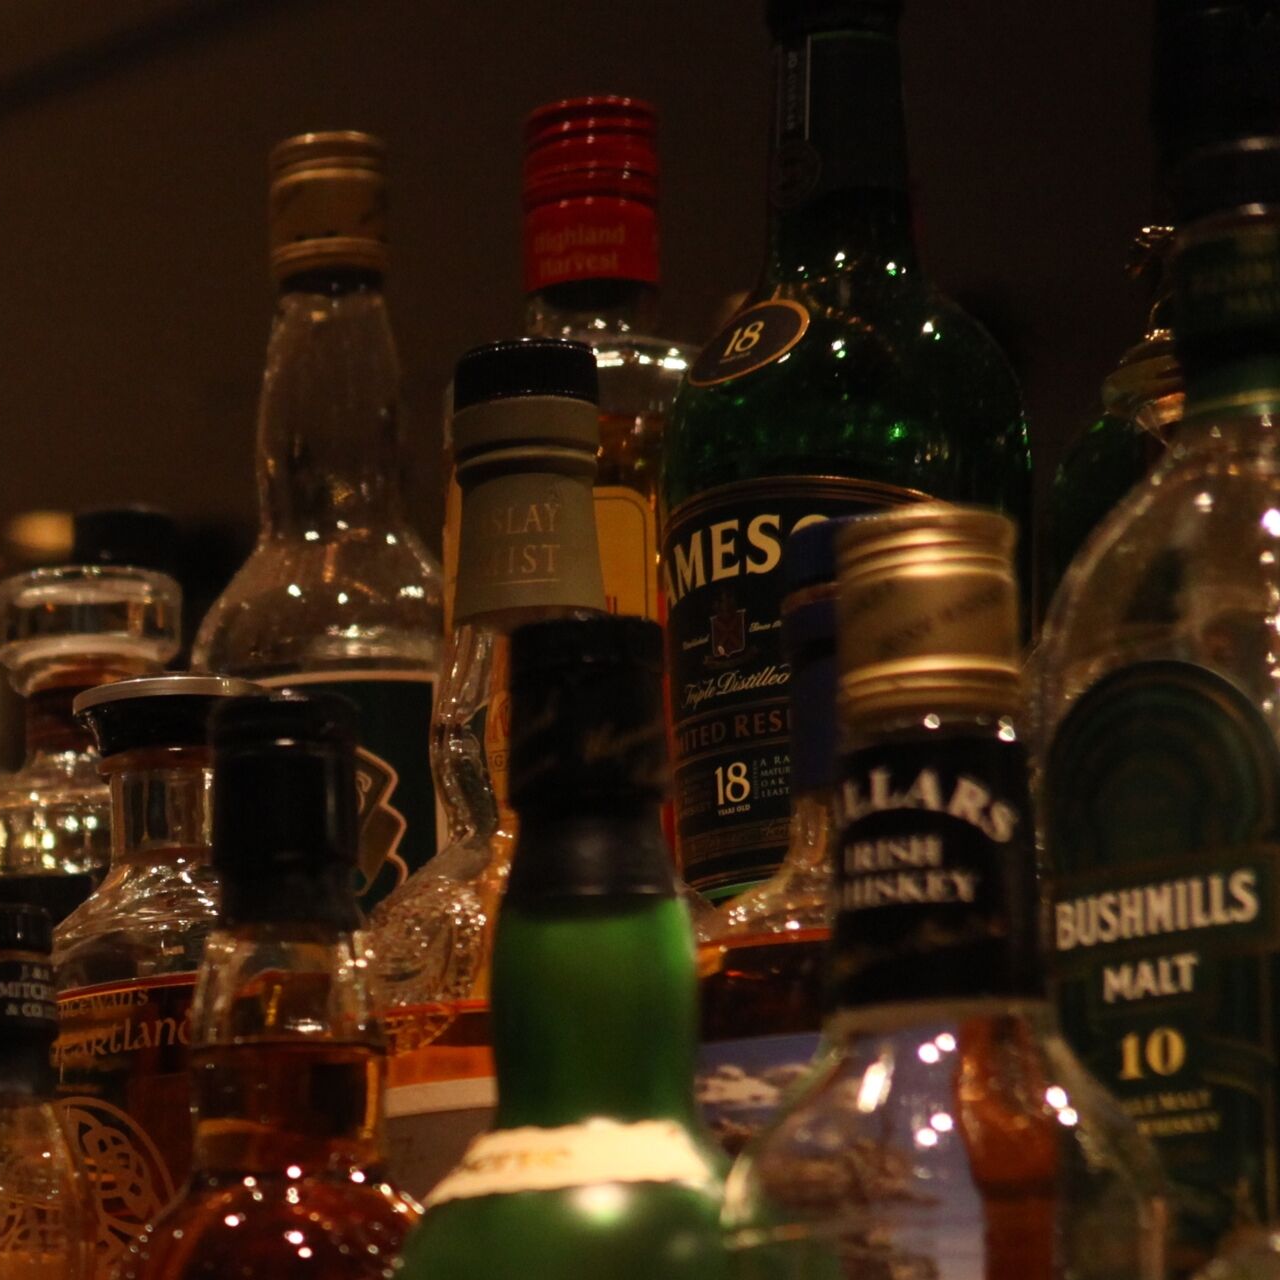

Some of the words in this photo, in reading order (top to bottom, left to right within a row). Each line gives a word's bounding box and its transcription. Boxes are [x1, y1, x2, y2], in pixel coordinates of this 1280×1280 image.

[723, 320, 766, 358] 18
[665, 513, 831, 609] AMES
[713, 761, 752, 806] 18
[1054, 868, 1259, 951] BUSHMILLS
[1102, 952, 1199, 1002] MALT
[1119, 1026, 1187, 1080] 10
